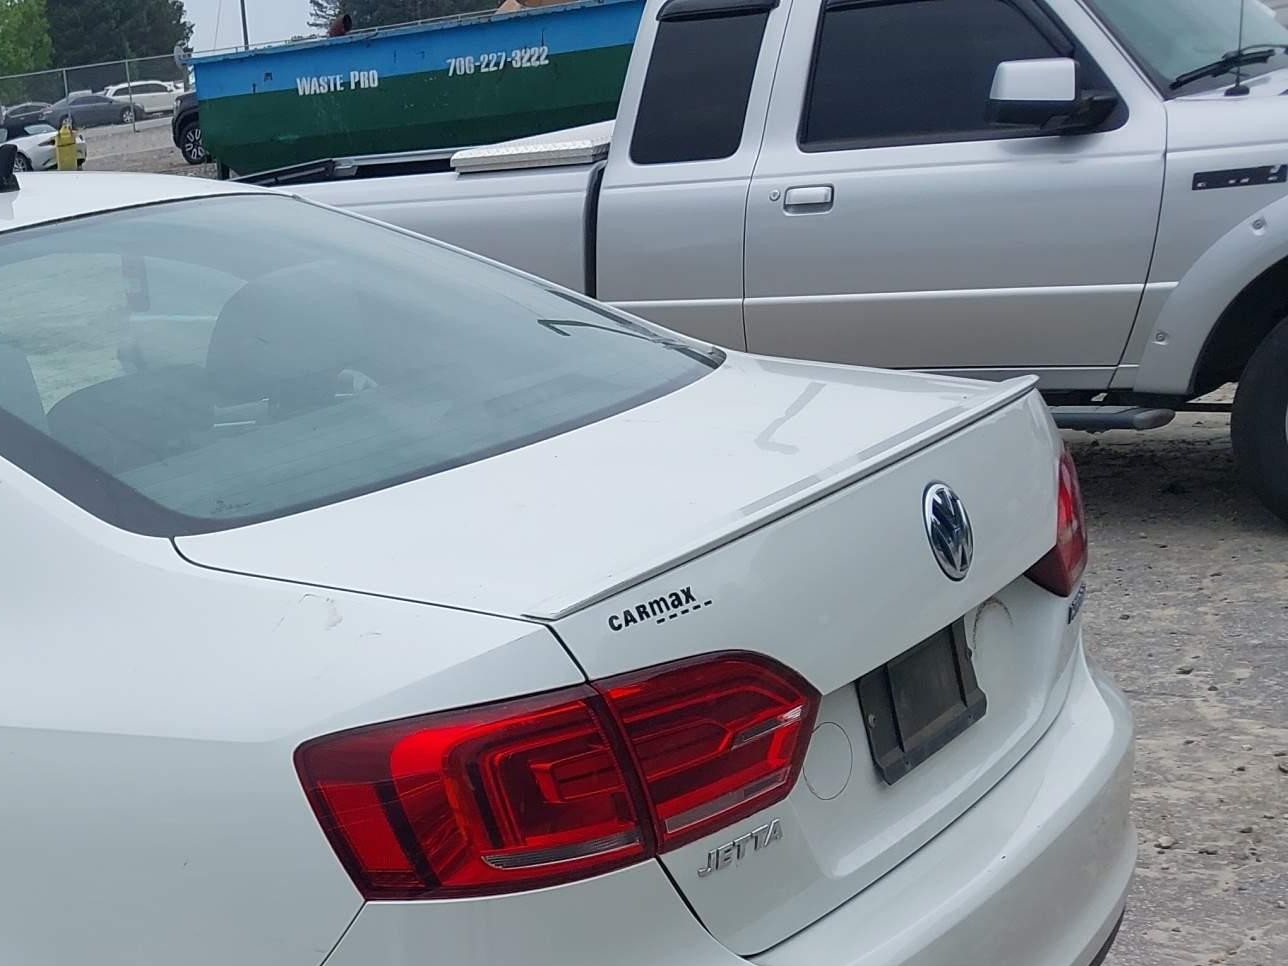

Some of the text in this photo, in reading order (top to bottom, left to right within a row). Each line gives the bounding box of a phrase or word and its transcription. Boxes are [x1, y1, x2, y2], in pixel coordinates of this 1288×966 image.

[446, 46, 549, 77] 706-227-3222
[296, 69, 379, 96] WASTE PRO
[697, 818, 783, 878] JETTA
